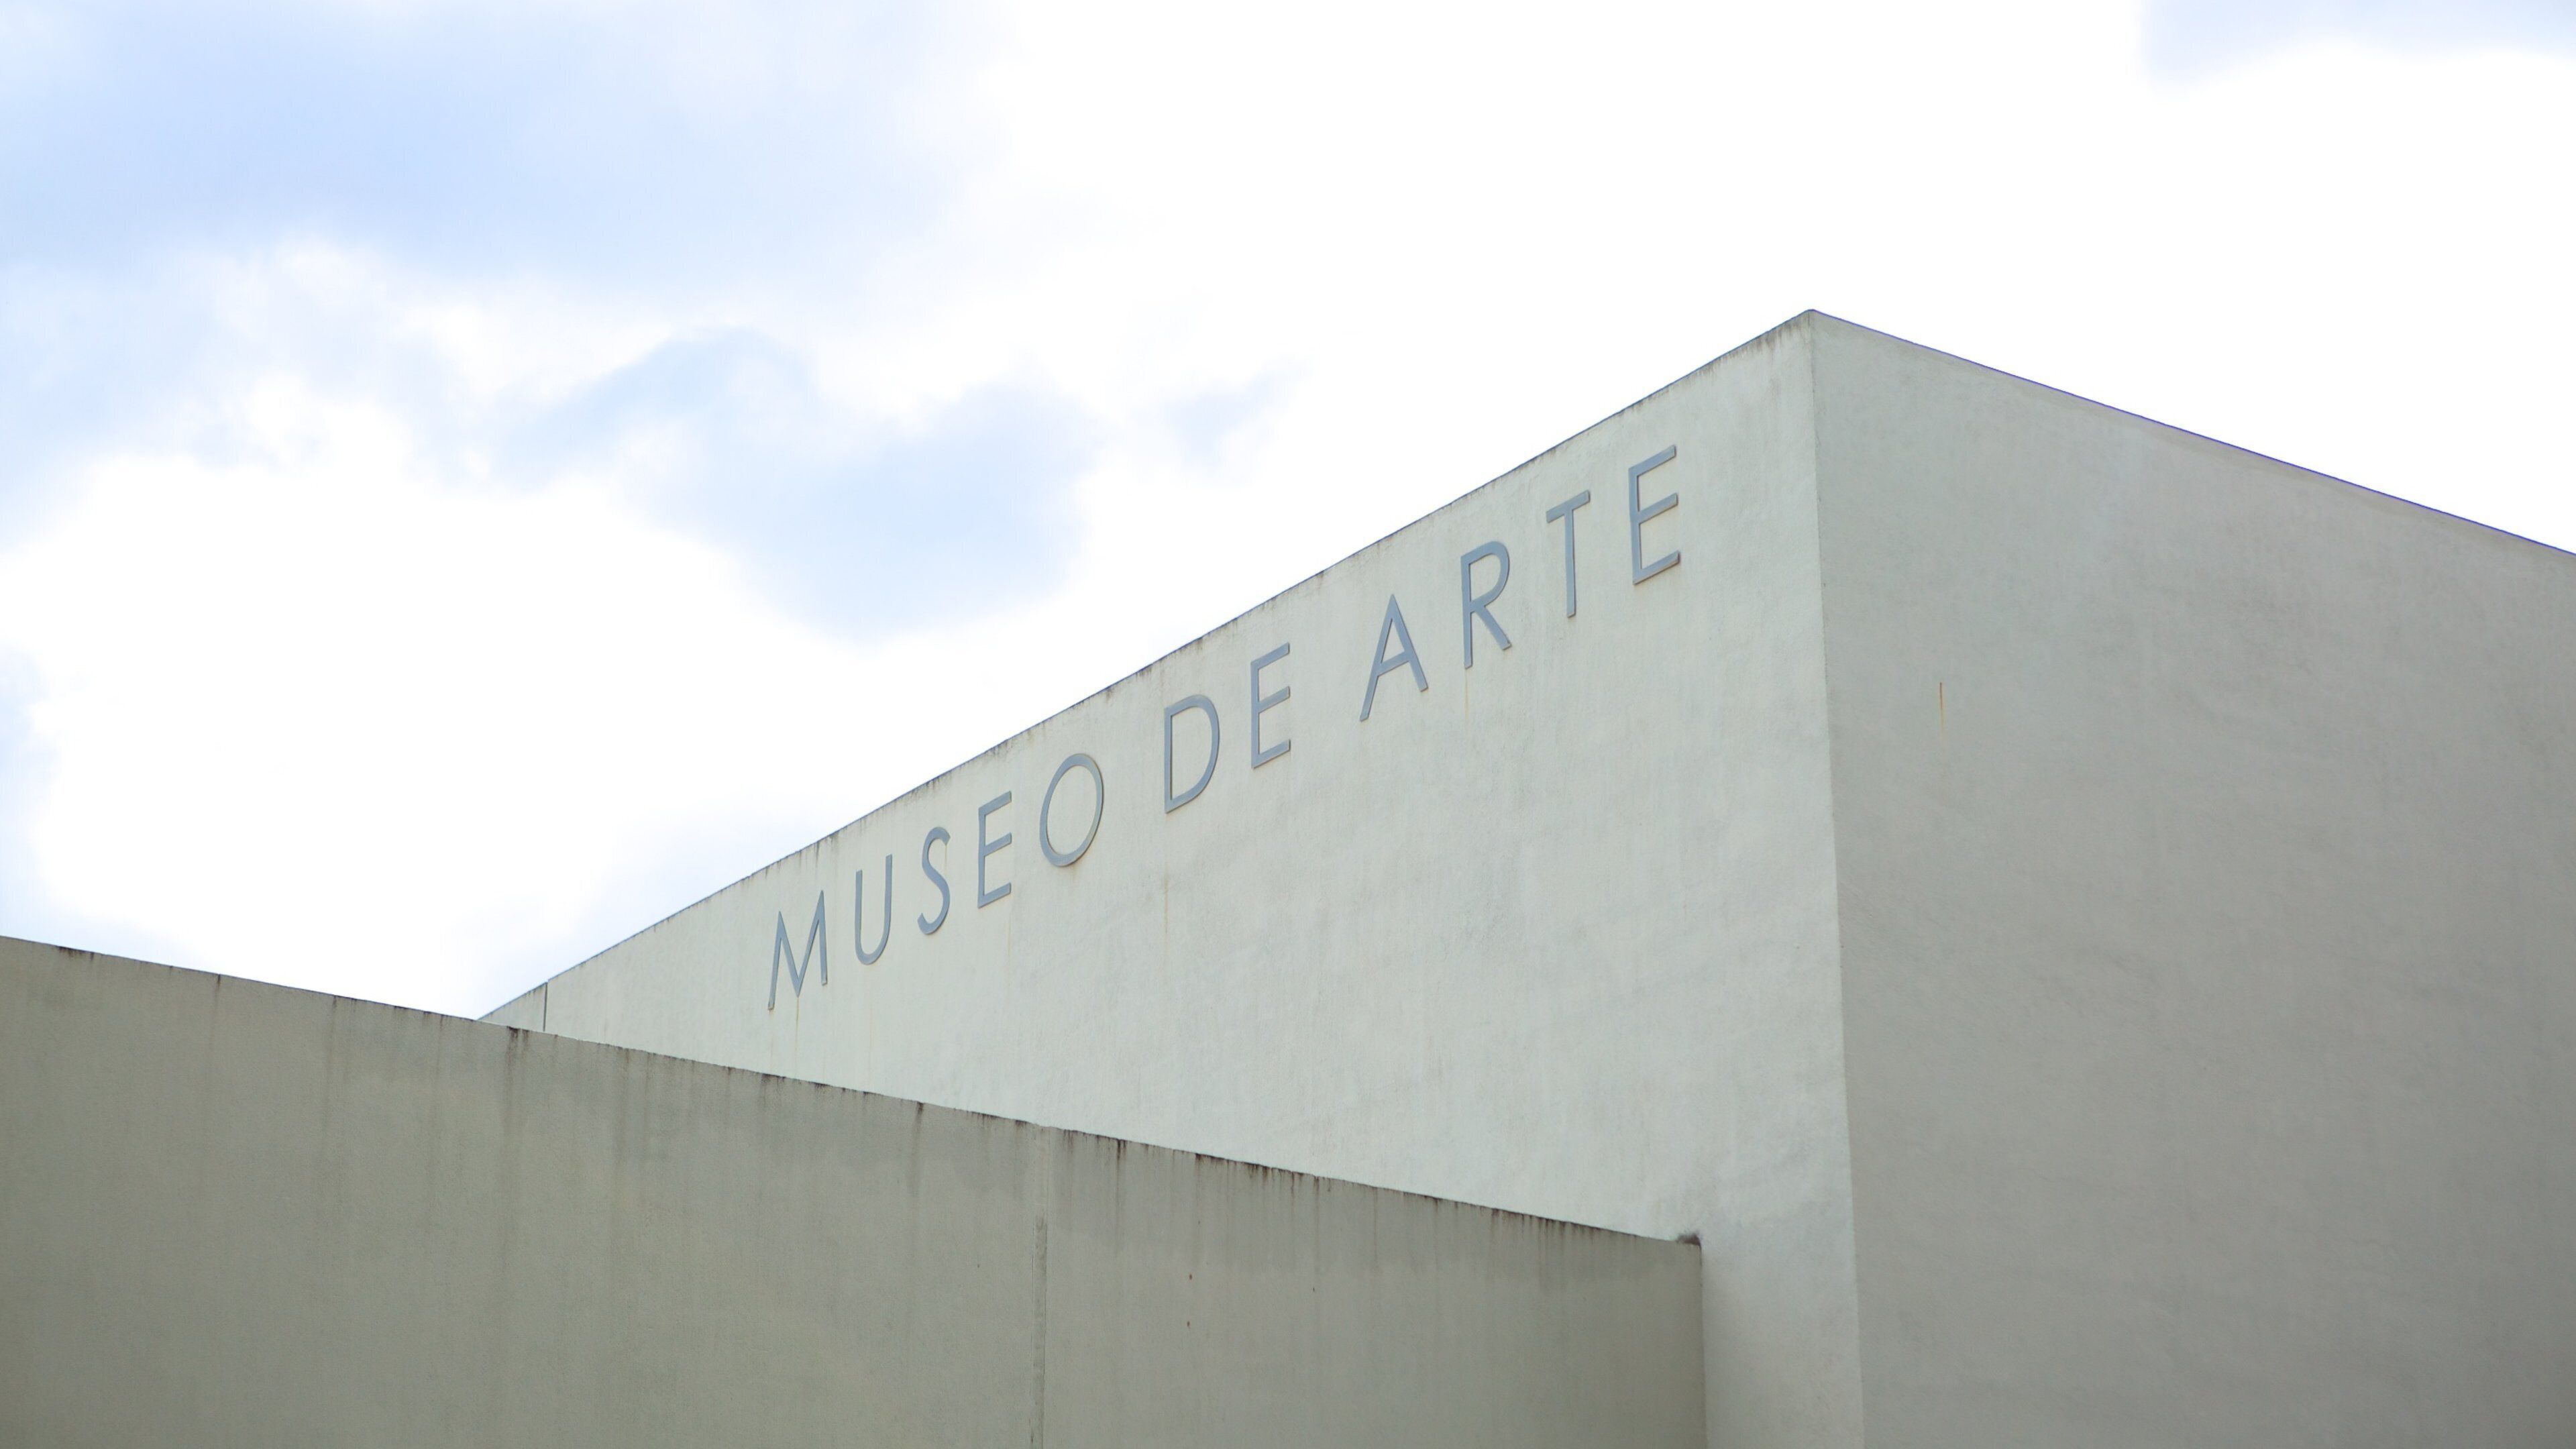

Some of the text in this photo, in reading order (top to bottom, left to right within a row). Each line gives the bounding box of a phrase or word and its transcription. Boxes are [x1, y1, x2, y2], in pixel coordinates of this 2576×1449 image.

[768, 444, 1680, 1011] MUSEO DE ARTE
